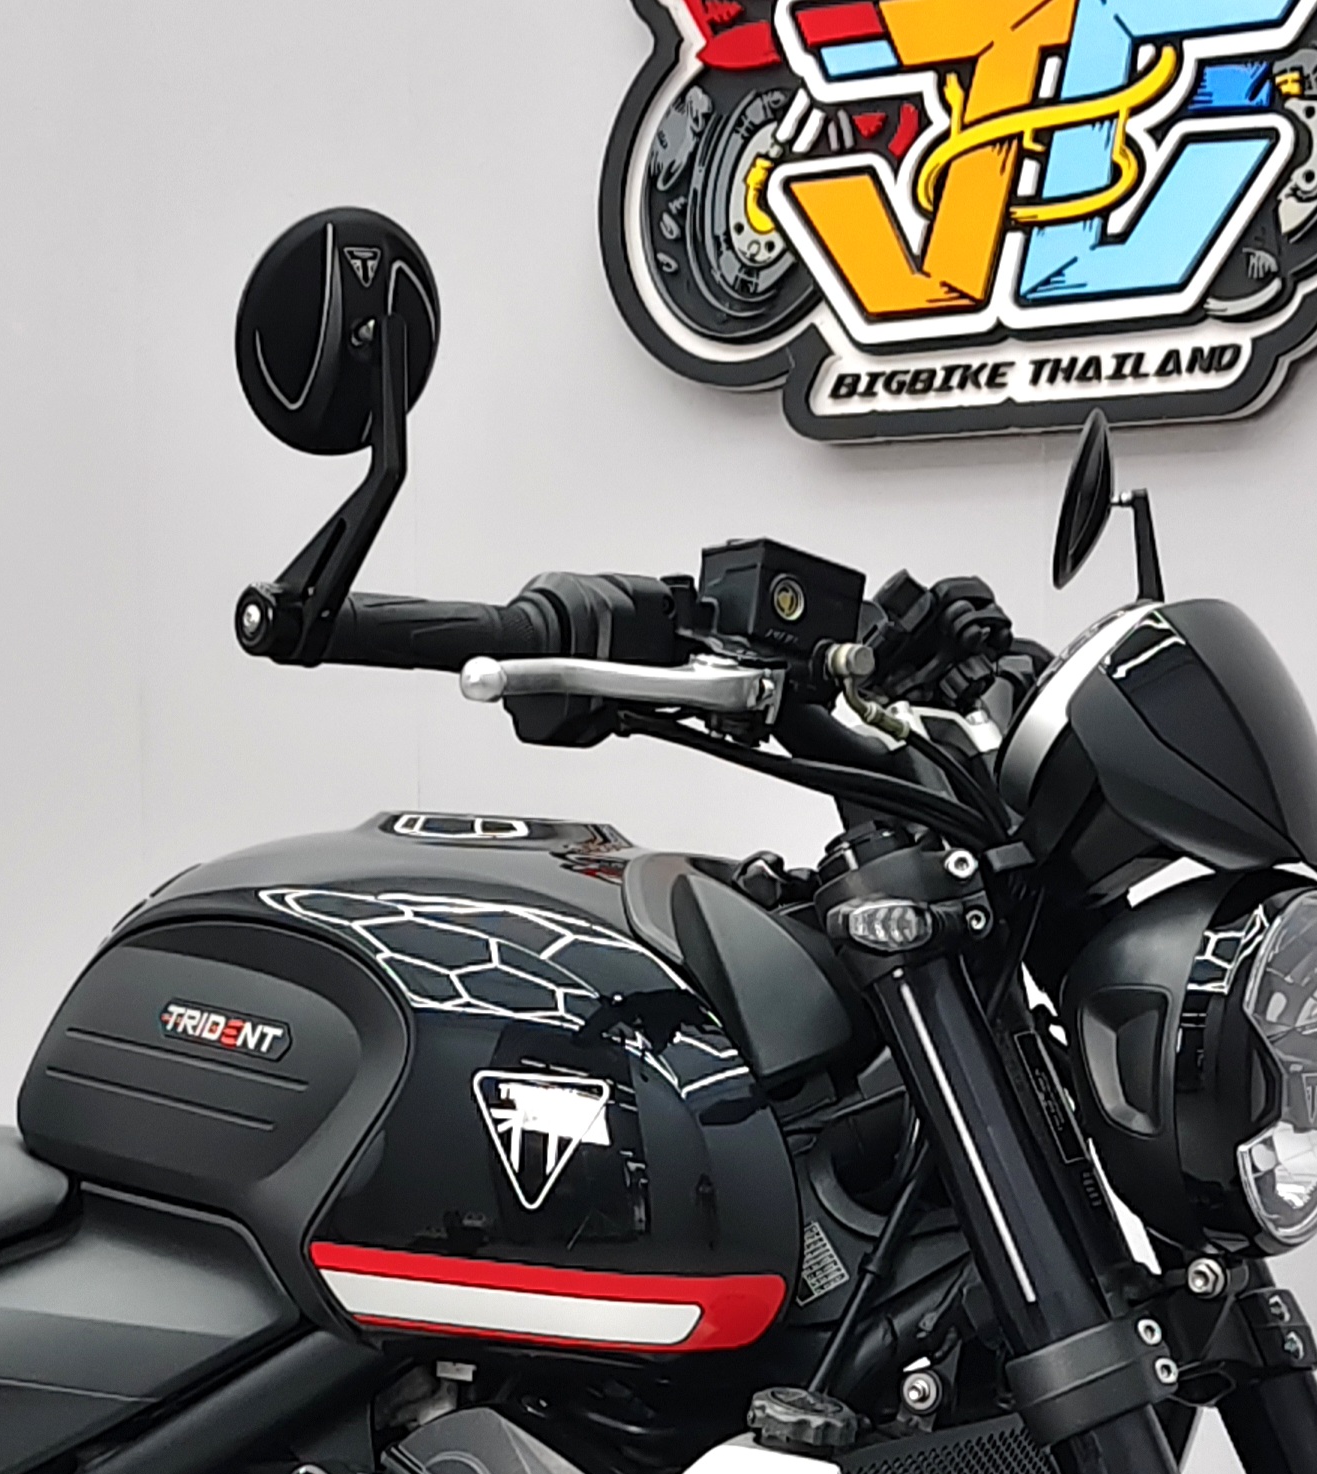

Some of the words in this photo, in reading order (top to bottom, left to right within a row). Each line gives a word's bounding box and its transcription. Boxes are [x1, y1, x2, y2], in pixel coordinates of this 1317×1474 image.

[829, 360, 1014, 400] BIGBIKE
[1028, 343, 1243, 388] THAILAND
[160, 1003, 284, 1053] TRIDENT
